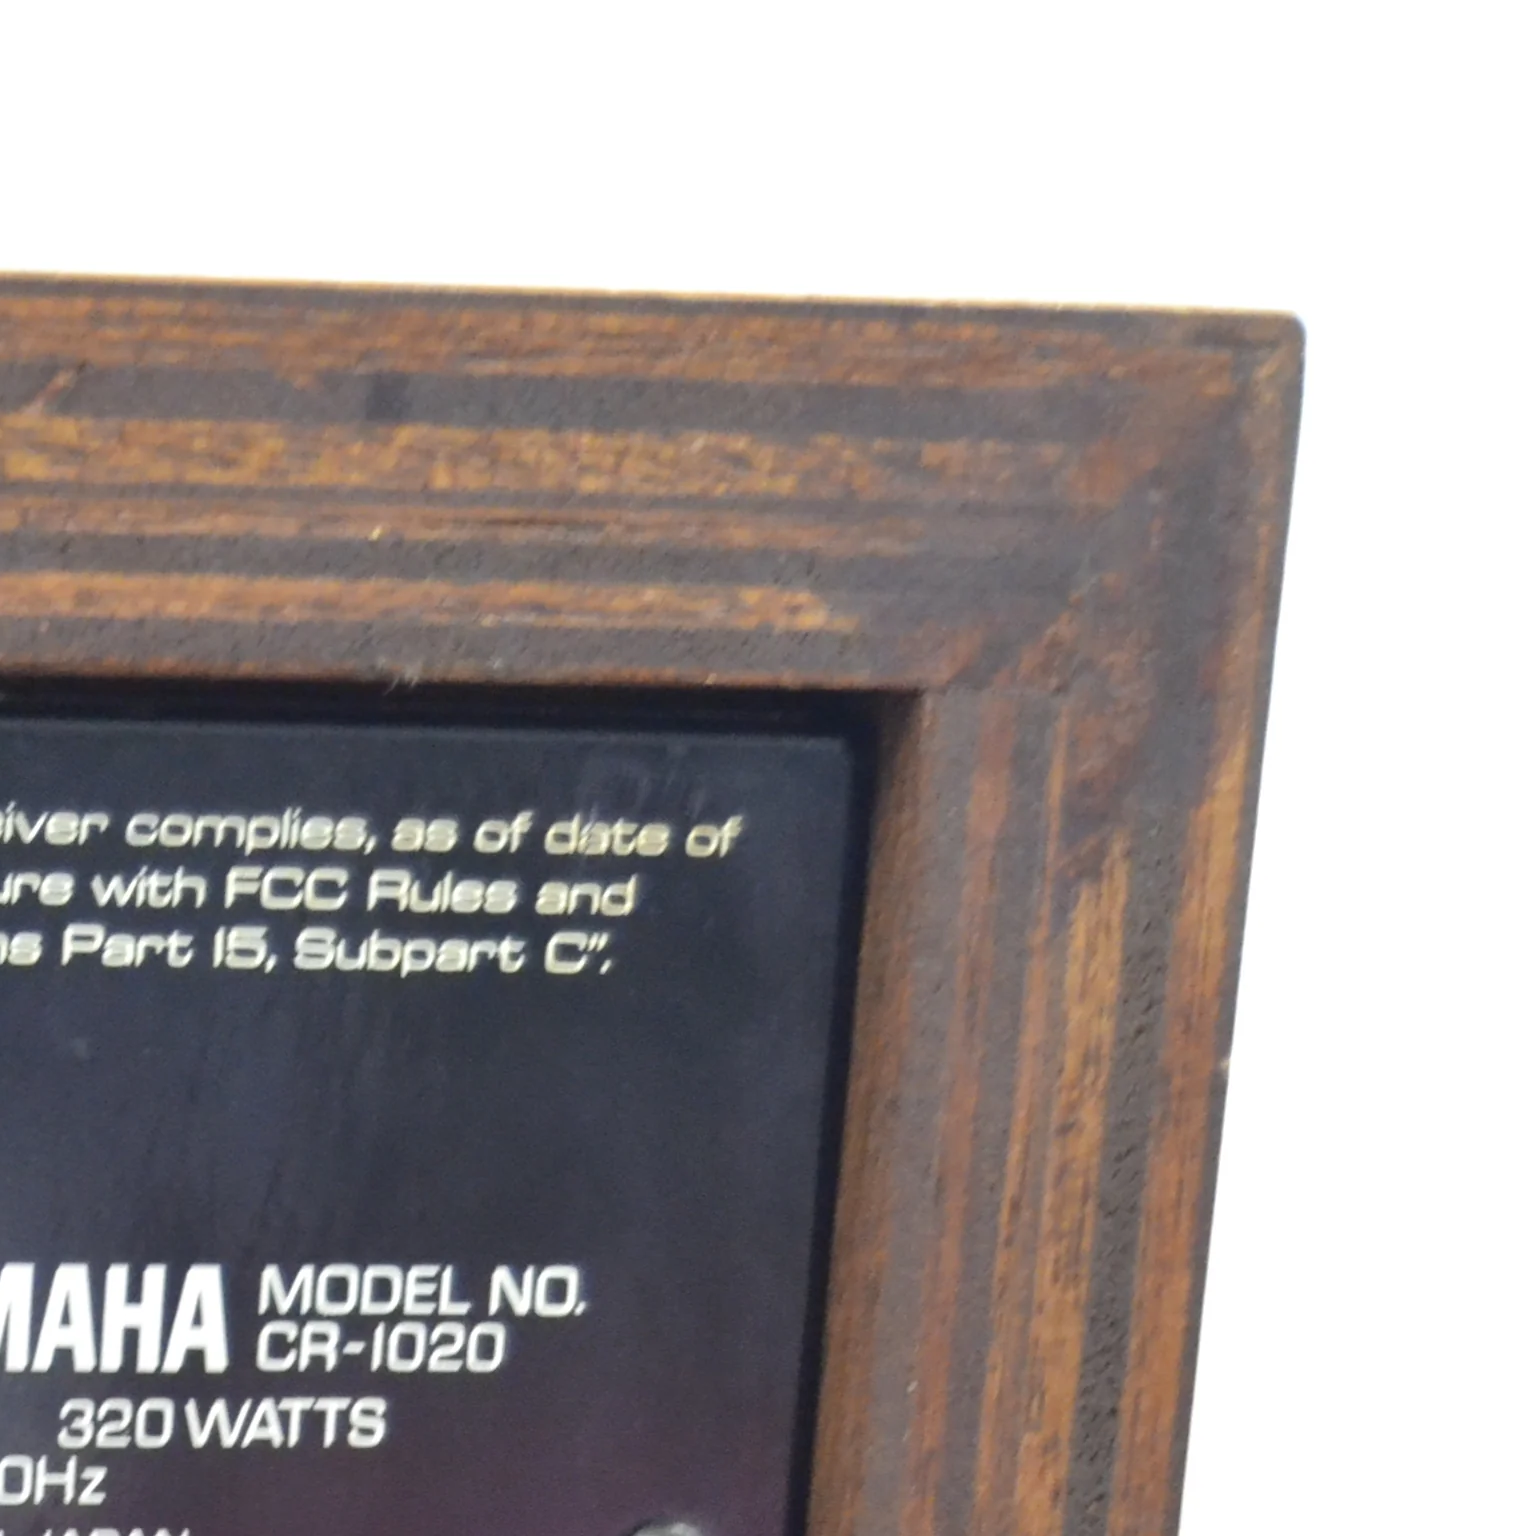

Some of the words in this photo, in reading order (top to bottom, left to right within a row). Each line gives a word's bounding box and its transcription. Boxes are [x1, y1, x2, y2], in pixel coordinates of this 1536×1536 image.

[126, 808, 376, 855] complies,
[392, 818, 458, 851] as
[474, 811, 532, 852] of
[545, 814, 670, 855] date
[686, 816, 742, 856] of
[92, 866, 206, 907] with
[225, 866, 348, 910] FCC
[367, 869, 517, 913] Rules
[536, 875, 636, 916] and
[62, 924, 193, 967] Part
[294, 927, 525, 977] Subpart
[258, 1265, 471, 1316] MODEL
[490, 1266, 586, 1316] NO.
[257, 1321, 506, 1372] CR-1020
